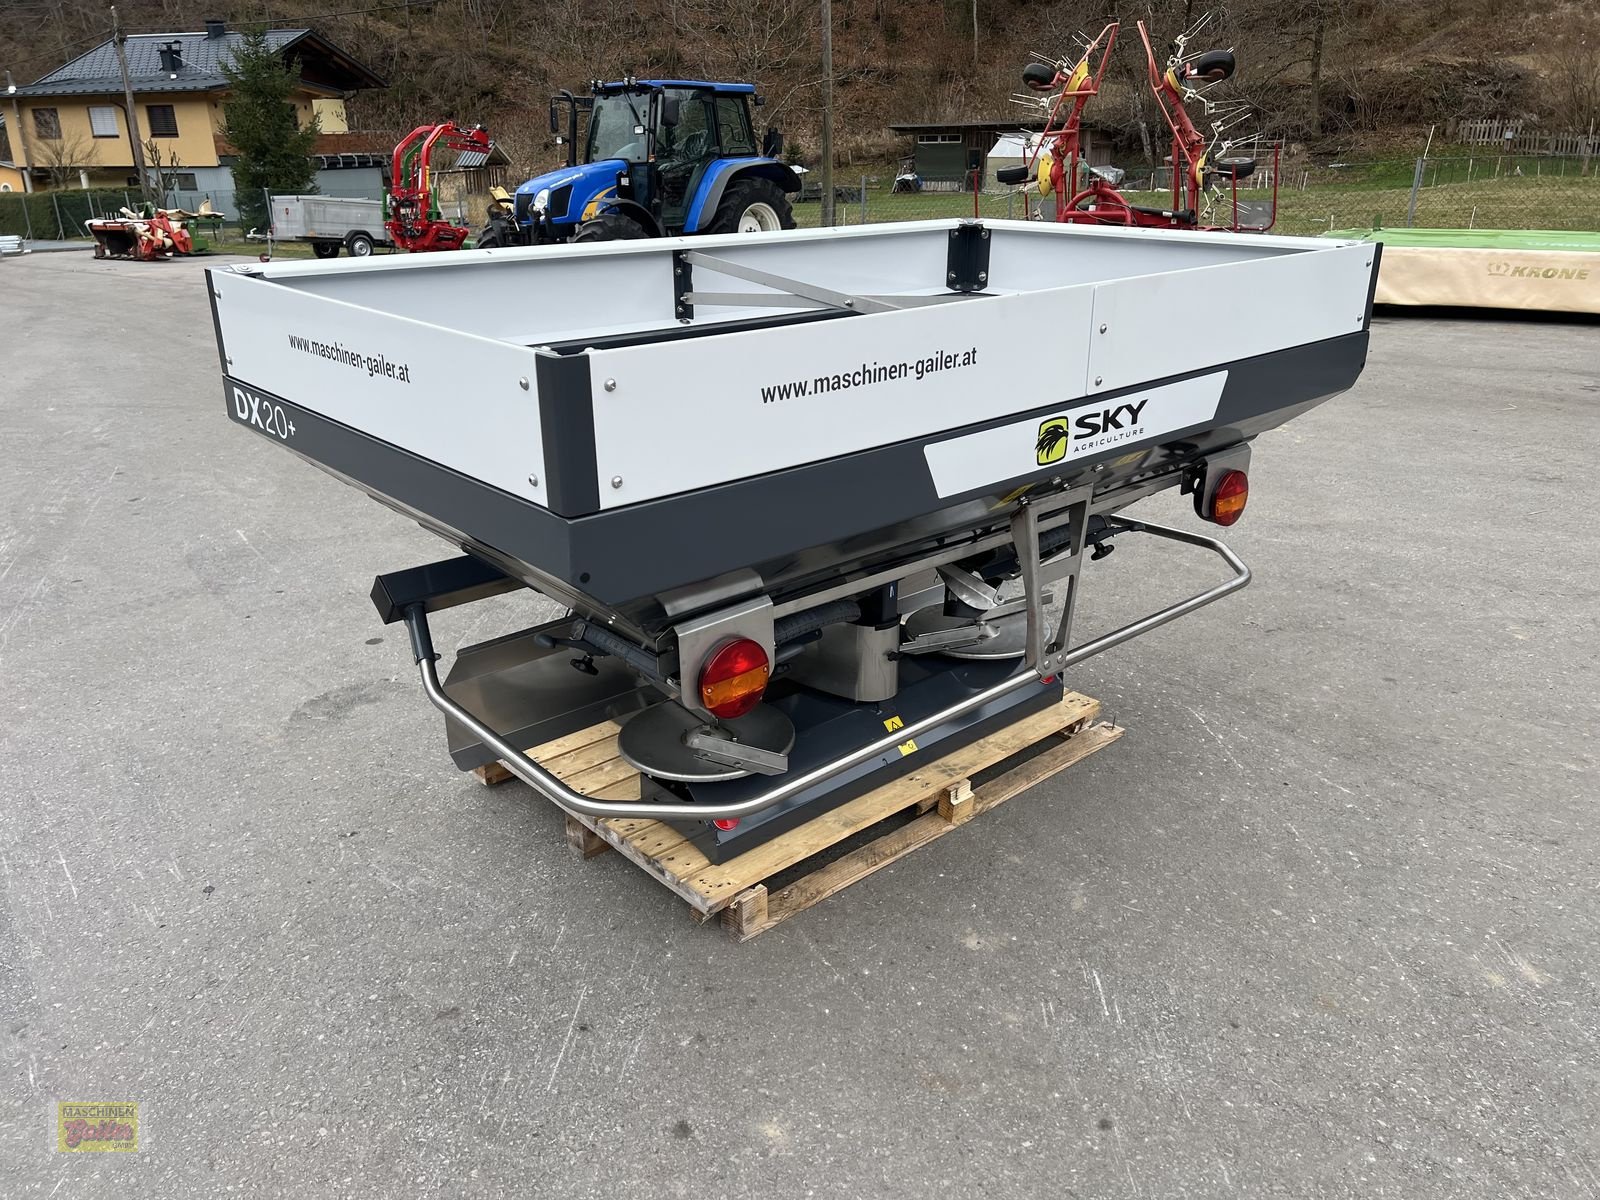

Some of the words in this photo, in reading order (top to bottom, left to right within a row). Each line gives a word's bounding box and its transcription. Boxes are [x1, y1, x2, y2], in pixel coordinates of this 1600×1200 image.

[1510, 266, 1591, 280] KRONE
[288, 333, 411, 383] www.maschinen-gailer.at
[761, 346, 978, 404] www.maschinen-gailer.at
[233, 386, 296, 440] DX20+
[1074, 398, 1149, 440] SKY
[1074, 427, 1145, 453] AGRICULTURE
